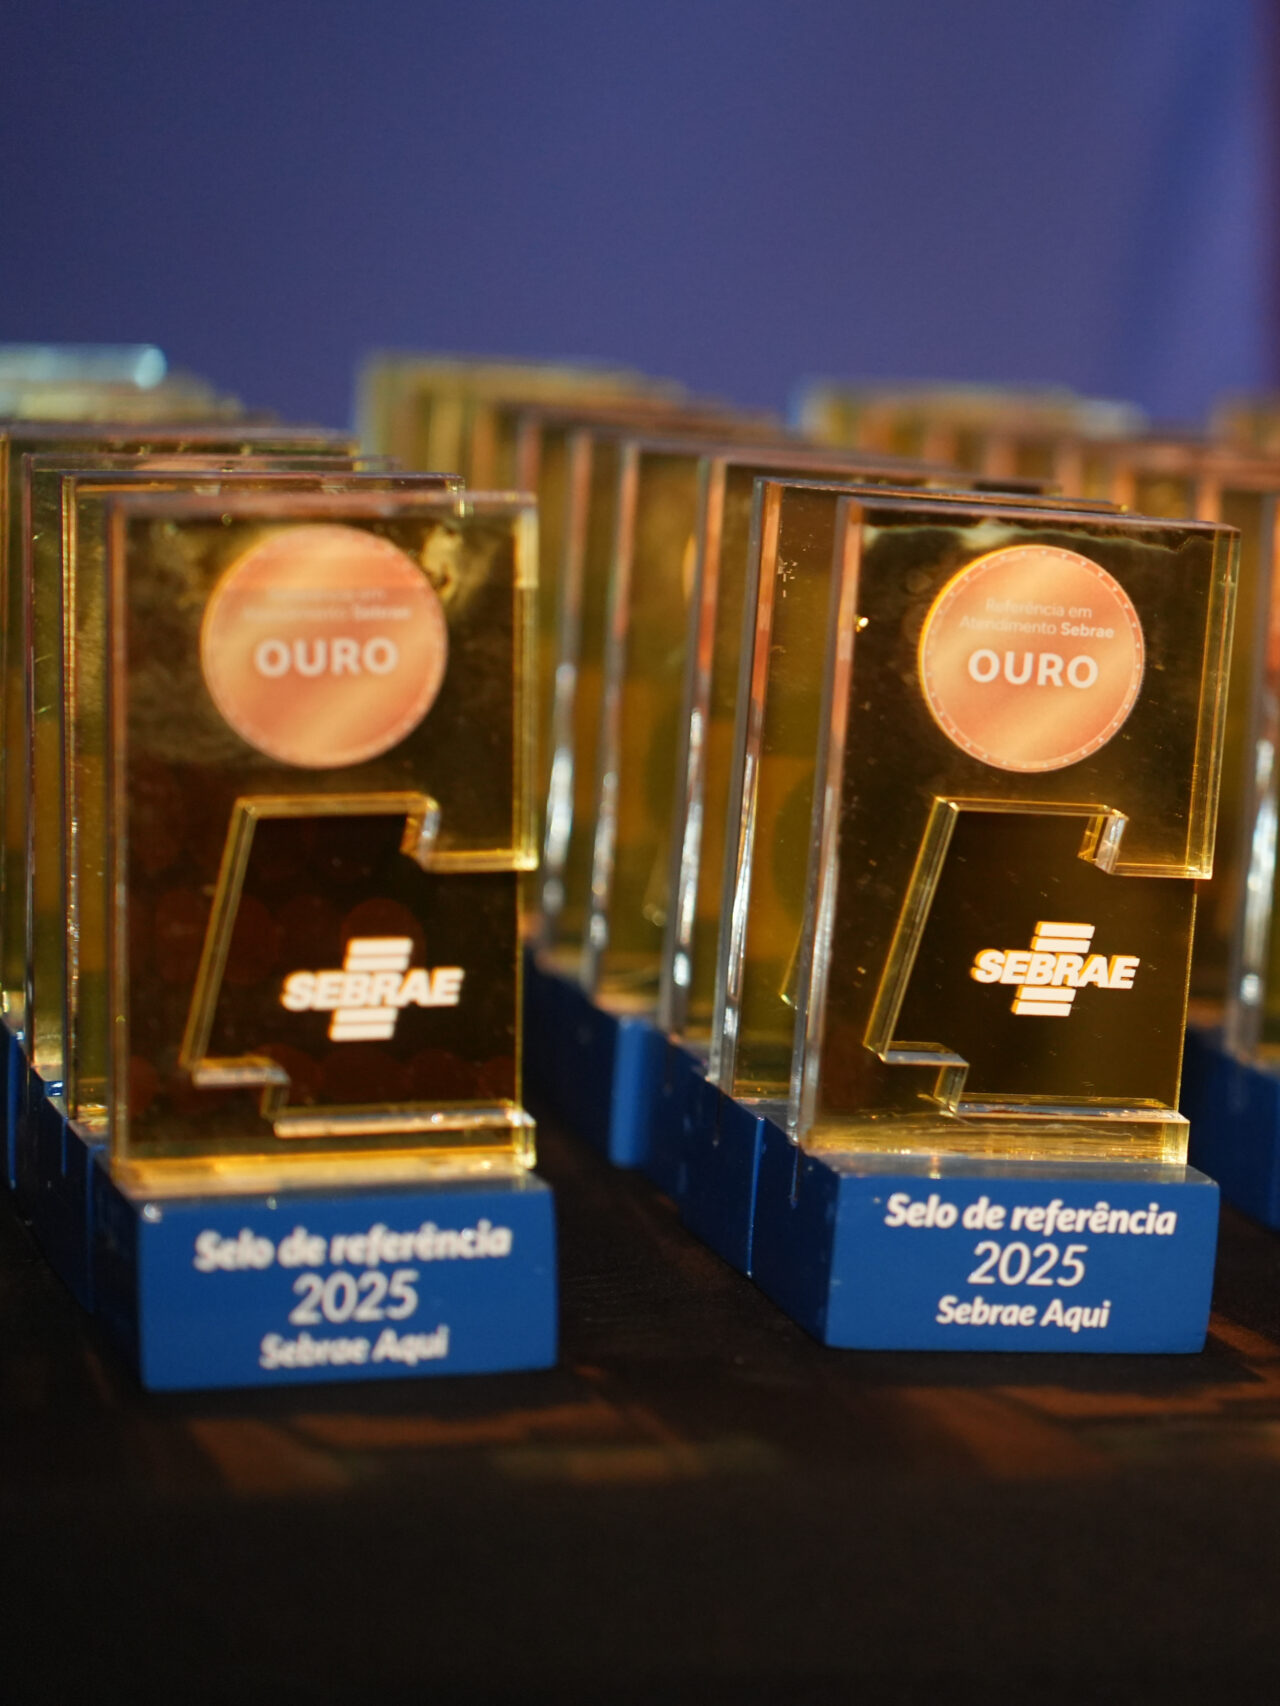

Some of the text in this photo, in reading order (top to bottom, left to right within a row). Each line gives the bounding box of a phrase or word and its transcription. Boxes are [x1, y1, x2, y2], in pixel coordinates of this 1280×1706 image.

[959, 615, 1115, 639] Atendimento Sebrae
[986, 597, 1093, 619] Referência em
[254, 636, 399, 678] OURO
[968, 648, 1099, 689] OURO
[280, 966, 465, 1012] SEBRAE
[970, 948, 1140, 989] SEBRAE
[885, 1193, 1178, 1237] Selo de referência
[194, 1228, 275, 1272] Selo
[277, 1225, 328, 1268] de
[967, 1240, 1089, 1287] 2025
[288, 1269, 420, 1326] 2025
[936, 1295, 1112, 1333] Sebrae Aqui
[258, 1323, 450, 1371] Sebrae Aqui
